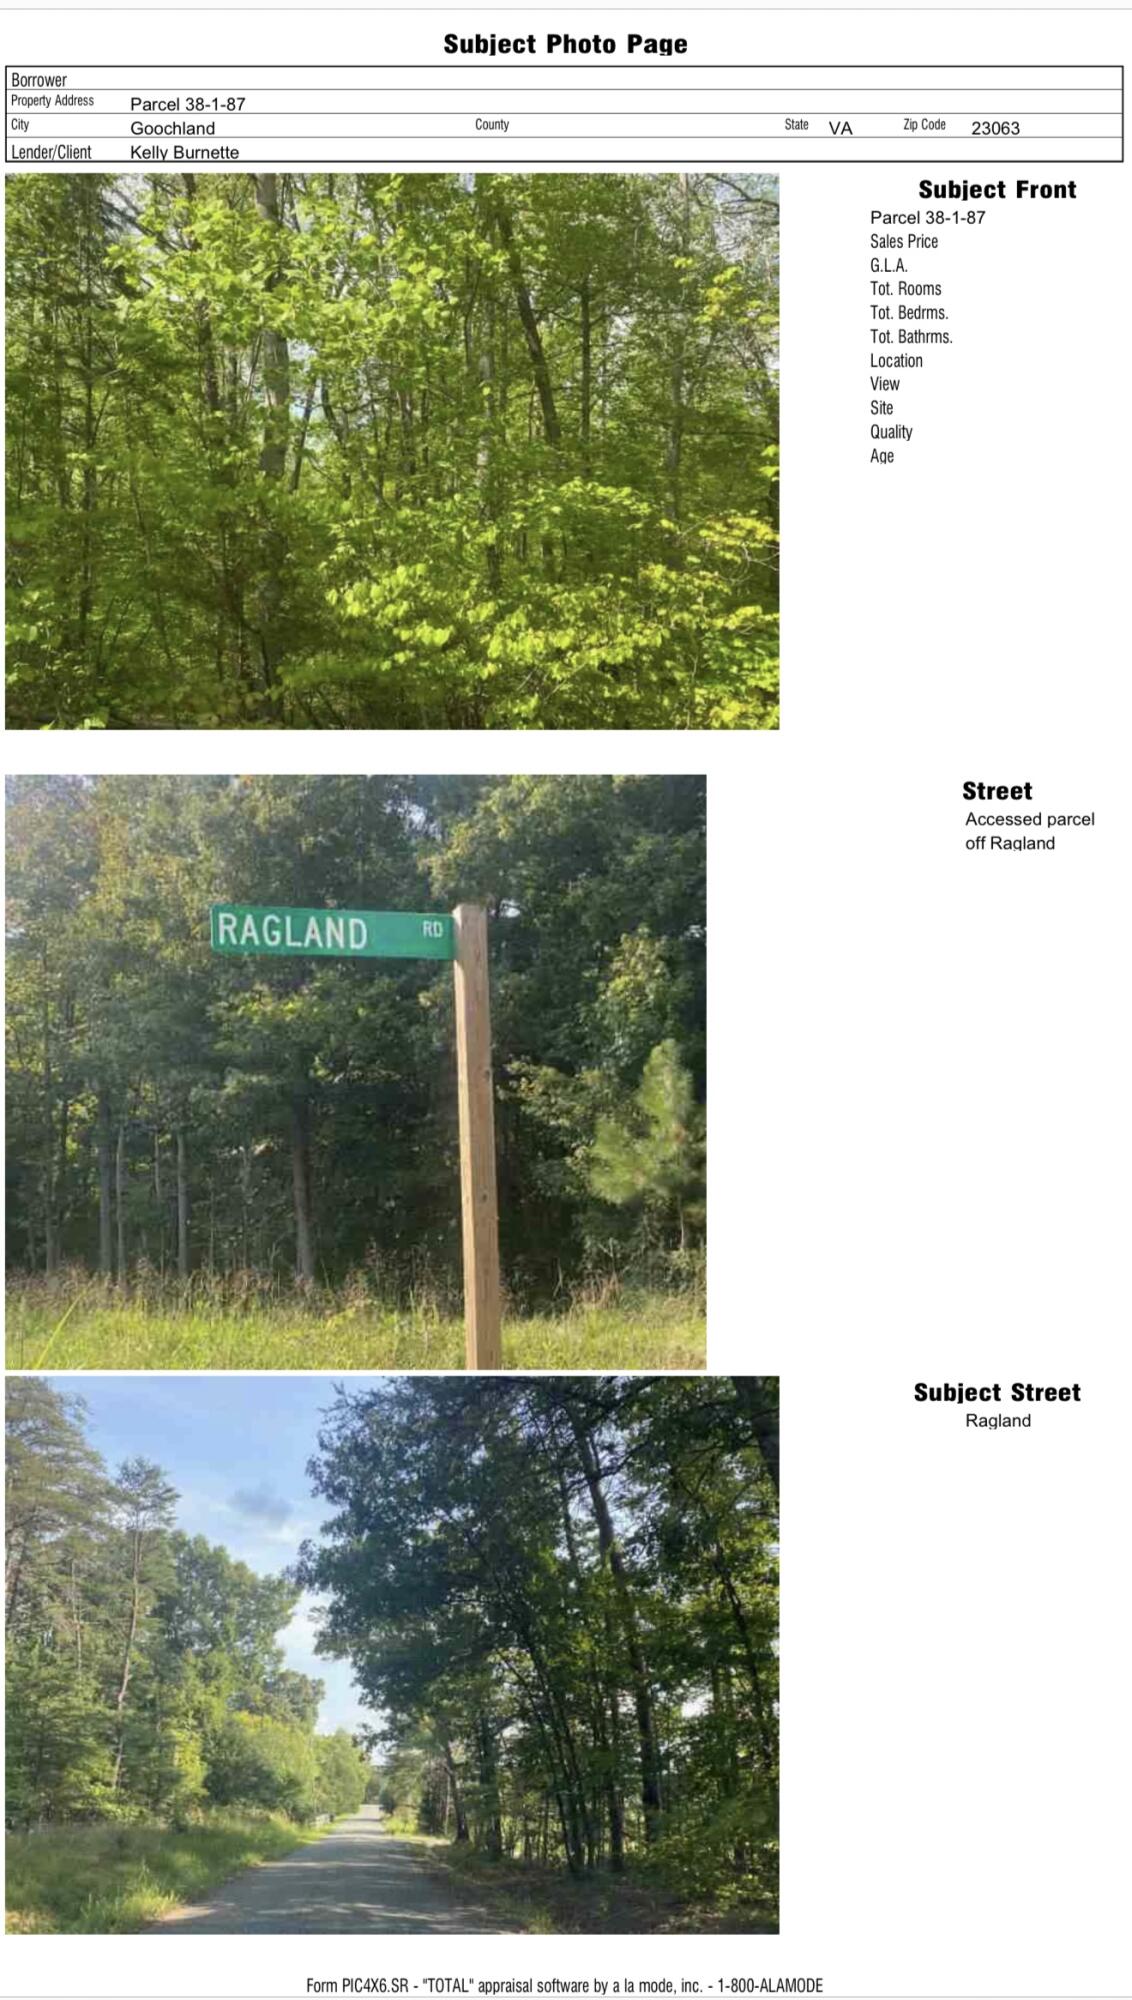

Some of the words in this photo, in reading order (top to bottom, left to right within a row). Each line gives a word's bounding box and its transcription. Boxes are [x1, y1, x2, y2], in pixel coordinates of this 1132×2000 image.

[443, 33, 537, 57] Subject
[546, 33, 617, 55] Photo
[627, 33, 688, 57] Page
[11, 72, 68, 88] Borrower
[11, 94, 52, 109] Property
[54, 94, 94, 106] Address
[130, 97, 180, 112] Parcel
[185, 97, 246, 112] 38-1-87
[11, 118, 30, 133] City
[130, 121, 215, 136] Goochland
[475, 118, 510, 133] County
[785, 118, 809, 131] State
[828, 121, 853, 136] VA
[903, 118, 918, 132] Zip
[921, 118, 946, 130] Code
[971, 121, 1021, 136] 23063
[11, 144, 92, 160] Lender/Client
[130, 145, 169, 161] Kelly
[173, 145, 240, 160] Burnette
[918, 179, 1007, 202] Subject
[1016, 179, 1077, 199] Front
[871, 210, 920, 225] Parcel
[925, 210, 986, 225] 38-1-87
[870, 233, 904, 249] Sales
[908, 233, 939, 249] Price
[870, 257, 908, 273] G.L.A.
[870, 280, 893, 296] Tot.
[898, 280, 942, 296] Rooms
[870, 304, 894, 320] Tot.
[898, 304, 949, 320] Bedrms.
[870, 328, 894, 344] Tot.
[898, 328, 953, 344] Bathrms.
[870, 353, 923, 368] Location
[870, 375, 901, 391] View
[870, 399, 894, 416] Site
[870, 423, 913, 442] Quality
[870, 448, 894, 465] Age
[962, 780, 1033, 801] Street
[965, 811, 1042, 826] Accessed
[1047, 812, 1095, 829] parcel
[965, 835, 987, 850] off
[990, 835, 1055, 852] Ragland
[217, 912, 368, 950] RAGLAND
[422, 919, 444, 938] RD
[914, 1382, 1002, 1405] Subject
[1011, 1382, 1082, 1402] Street
[966, 1413, 1031, 1430] Ragland
[306, 1977, 338, 1993] Form
[342, 1977, 409, 1993] PIC4X6.SR
[422, 1977, 474, 1993] "TOTAL"
[478, 1978, 533, 1996] appraisal
[536, 1978, 590, 1993] software
[594, 1977, 609, 1996] by
[612, 1981, 620, 1993] a
[624, 1977, 635, 1993] la
[639, 1978, 677, 1994] mode,
[681, 1978, 703, 1993] inc.
[718, 1977, 823, 1993] 1-800-ALAMODE
